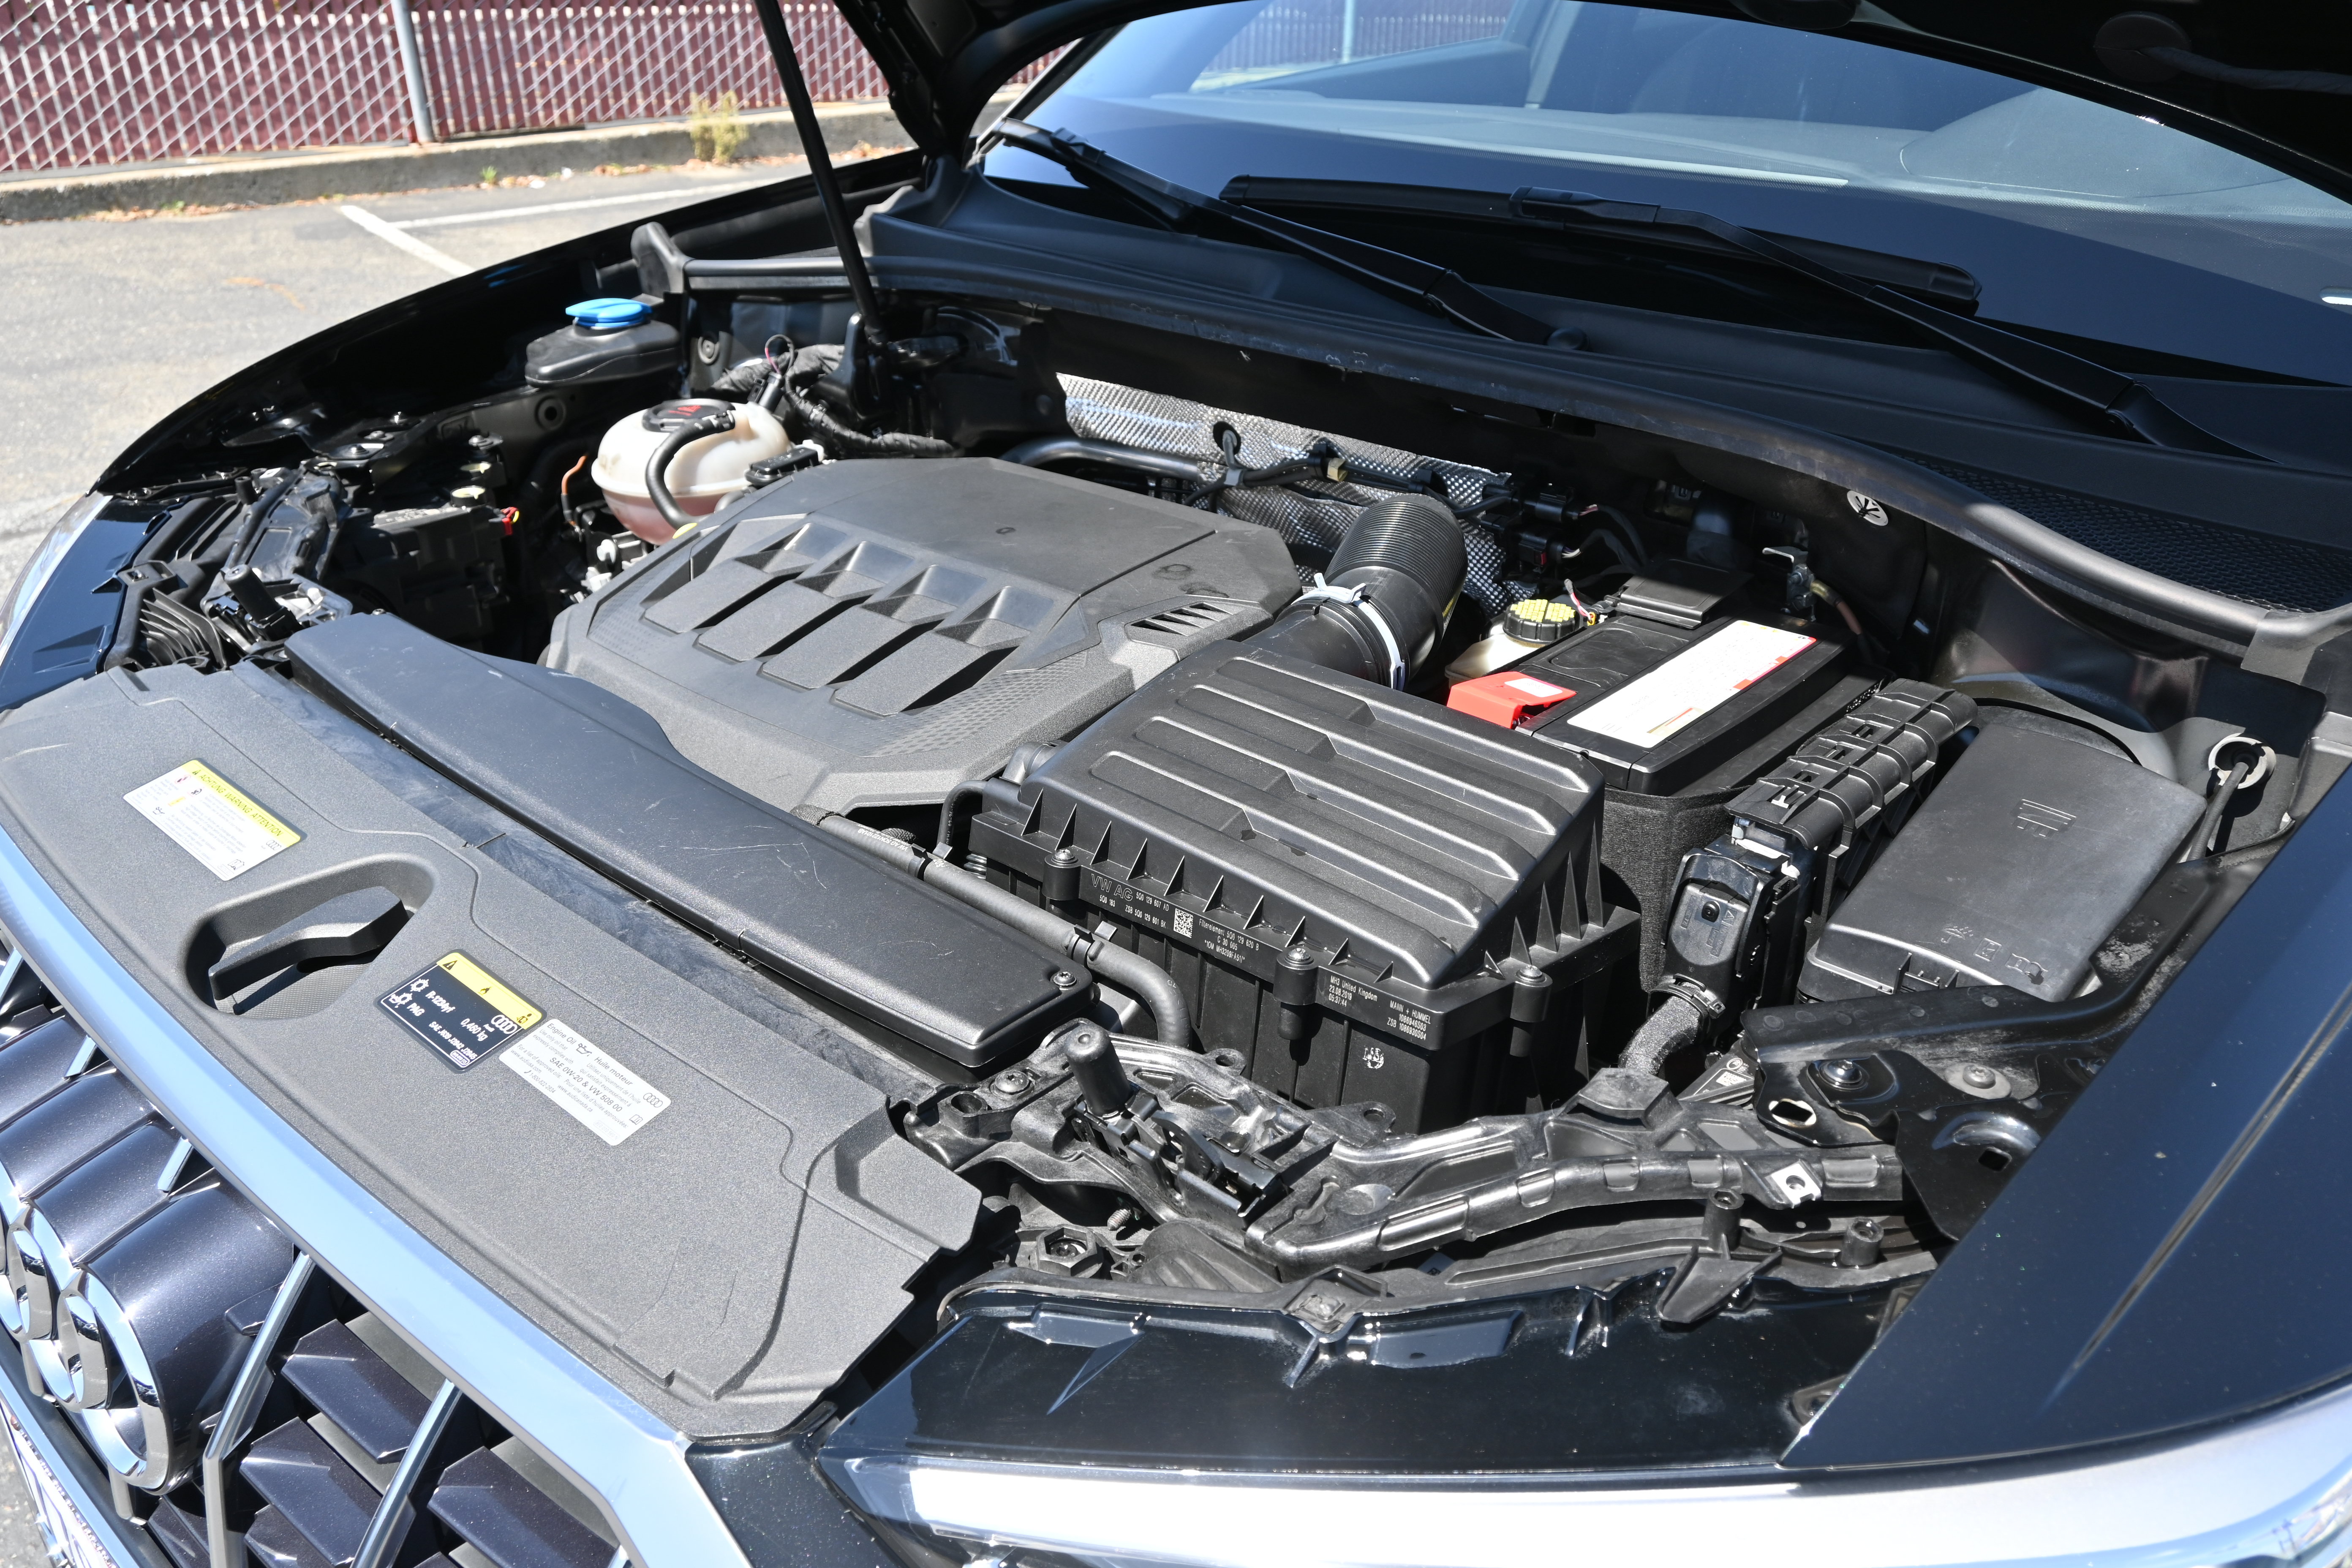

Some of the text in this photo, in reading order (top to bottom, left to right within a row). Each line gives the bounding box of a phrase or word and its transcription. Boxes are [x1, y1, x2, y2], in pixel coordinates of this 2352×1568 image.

[200, 774, 226, 793] ACHTUNG
[224, 794, 252, 813] WARNING
[252, 813, 283, 836] ATTENTION
[1091, 873, 1133, 901] VW AG
[1099, 895, 1108, 904] 5Q0
[1136, 892, 1144, 901] 5Q0
[1154, 899, 1162, 908] 607
[1125, 904, 1133, 914] ZSB
[1134, 909, 1143, 918] 5Q0
[1160, 920, 1167, 929] BK
[1199, 918, 1225, 936] Filterelement
[1226, 931, 1235, 941] 5Q0
[1246, 939, 1254, 949] 620
[1255, 943, 1259, 951] B
[1217, 935, 1238, 951] C 30 005
[1328, 985, 1352, 1001] 23.08.2019
[1328, 993, 1348, 1007] 05:37:44
[1330, 975, 1378, 1002] MH3 United Kingdom
[406, 1002, 425, 1016] PAG
[428, 1021, 442, 1032] SAE
[437, 1029, 452, 1040] J639
[425, 990, 488, 1041] R-1234yf 0,460 kg
[1390, 1000, 1404, 1013] MANN
[1411, 1009, 1431, 1024] HUMMEL
[1398, 1013, 1427, 1032] 1086946S03
[547, 1023, 577, 1045] Engine Oil
[1387, 1017, 1427, 1041] ZSB 1086930S04
[533, 1034, 550, 1047] expressly
[548, 1046, 565, 1059] complies
[510, 1049, 542, 1073] www.audiusa.com
[536, 1059, 555, 1073] approved
[594, 1056, 633, 1085] Huile moteur
[530, 1073, 555, 1093] 1-800-822-2834
[550, 1057, 564, 1068] SAE
[562, 1067, 583, 1082] 0W-20
[589, 1085, 602, 1095] VW
[600, 1094, 614, 1105] 508
[612, 1104, 622, 1112] 00
[586, 1063, 601, 1075] Utilisez
[599, 1073, 623, 1091] uniquement
[628, 1093, 641, 1104] l'huile
[586, 1073, 602, 1085] satisfait
[600, 1084, 628, 1105] expressément
[557, 1084, 593, 1112] www.audicanada.ca
[564, 1078, 574, 1087] Pour
[580, 1091, 590, 1099] liste
[588, 1098, 604, 1111] d'huiles
[603, 1110, 628, 1128] approuvées:
